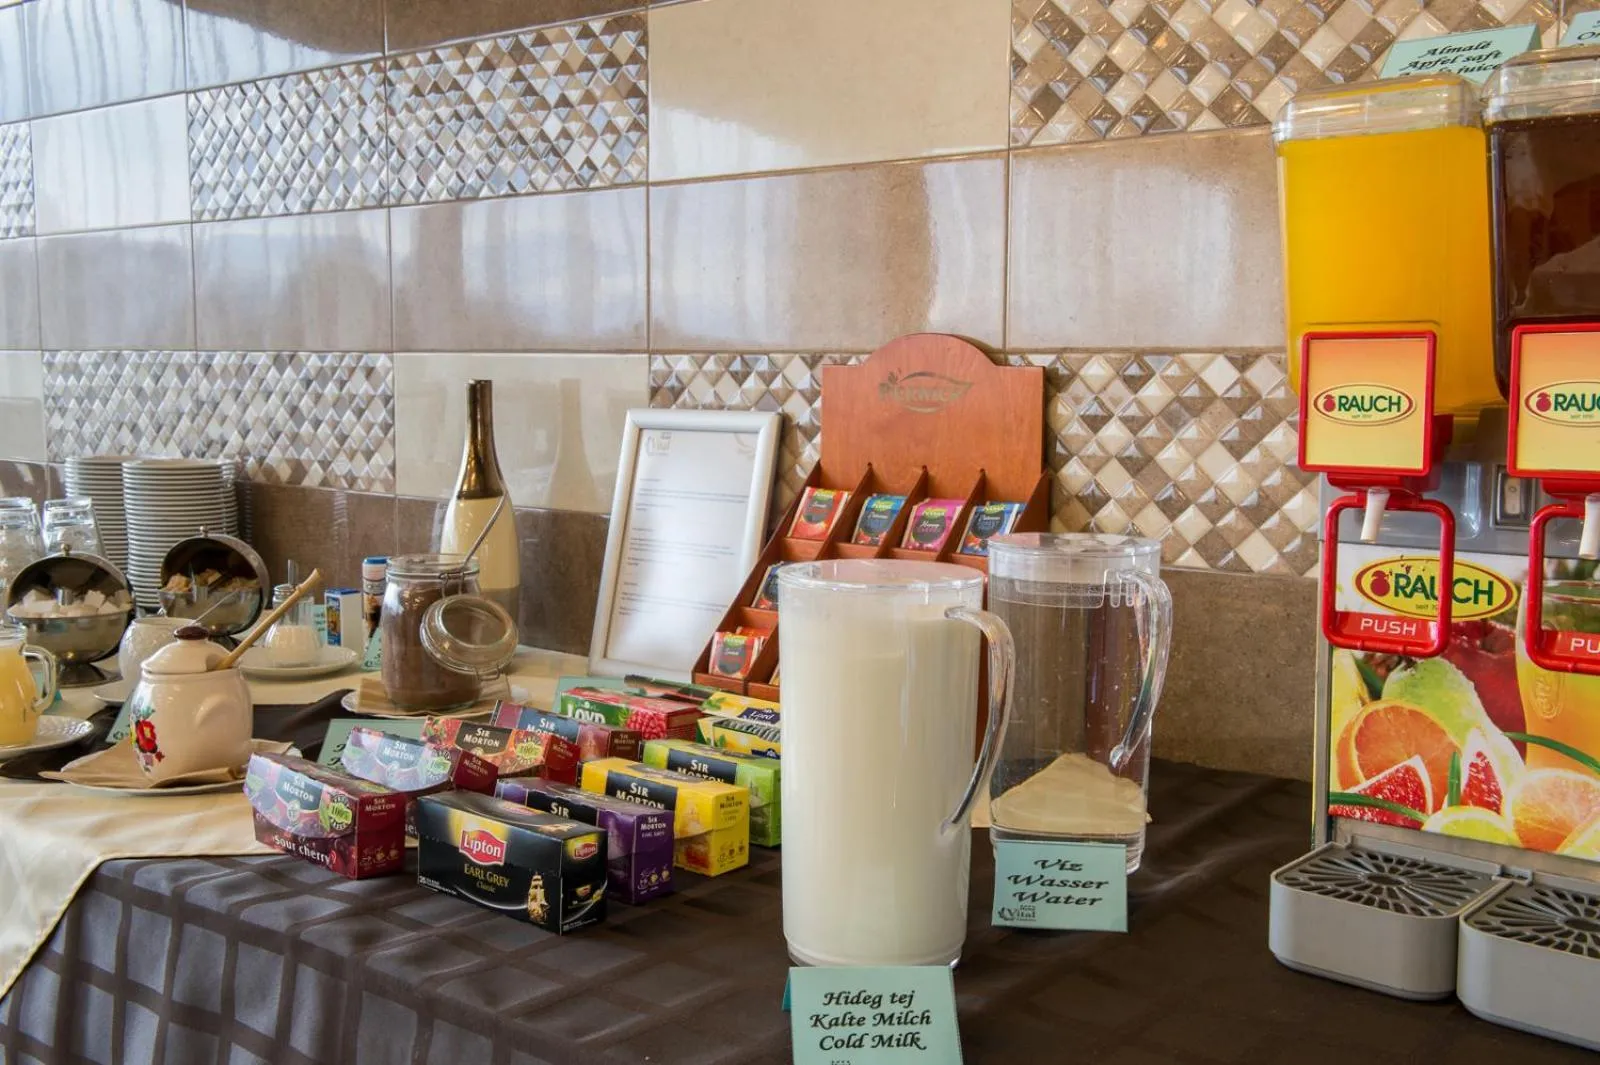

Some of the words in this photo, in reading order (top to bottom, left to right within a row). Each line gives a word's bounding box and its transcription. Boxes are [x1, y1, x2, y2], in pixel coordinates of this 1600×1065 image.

[1399, 54, 1464, 71] Apfel
[1462, 50, 1502, 64] saft
[1337, 395, 1401, 413] RAUCH
[1554, 393, 1600, 412] RAU
[1360, 617, 1417, 636] PUSH
[475, 727, 491, 737] SIR
[540, 717, 556, 731] SIR
[463, 734, 500, 747] MORTON
[383, 747, 415, 761] MORTON
[691, 759, 709, 773] SIR
[282, 781, 314, 803] MORTON
[630, 782, 649, 798] SIR
[364, 803, 397, 812] MORTON
[550, 801, 570, 818] SIR
[640, 823, 667, 831] MORTON
[272, 834, 296, 852] Sour
[299, 844, 331, 867] cherry
[463, 834, 501, 858] Lipton
[464, 863, 485, 880] EARL
[486, 871, 510, 888] GREY
[1008, 874, 1110, 890] Wasser
[1012, 891, 1103, 906] Water
[822, 989, 883, 1009] Hideg
[889, 990, 916, 1009] tej
[809, 1011, 866, 1030] Kalte
[872, 1010, 932, 1027] Milch
[819, 1033, 869, 1051] Cold
[871, 1031, 928, 1051] Milk
